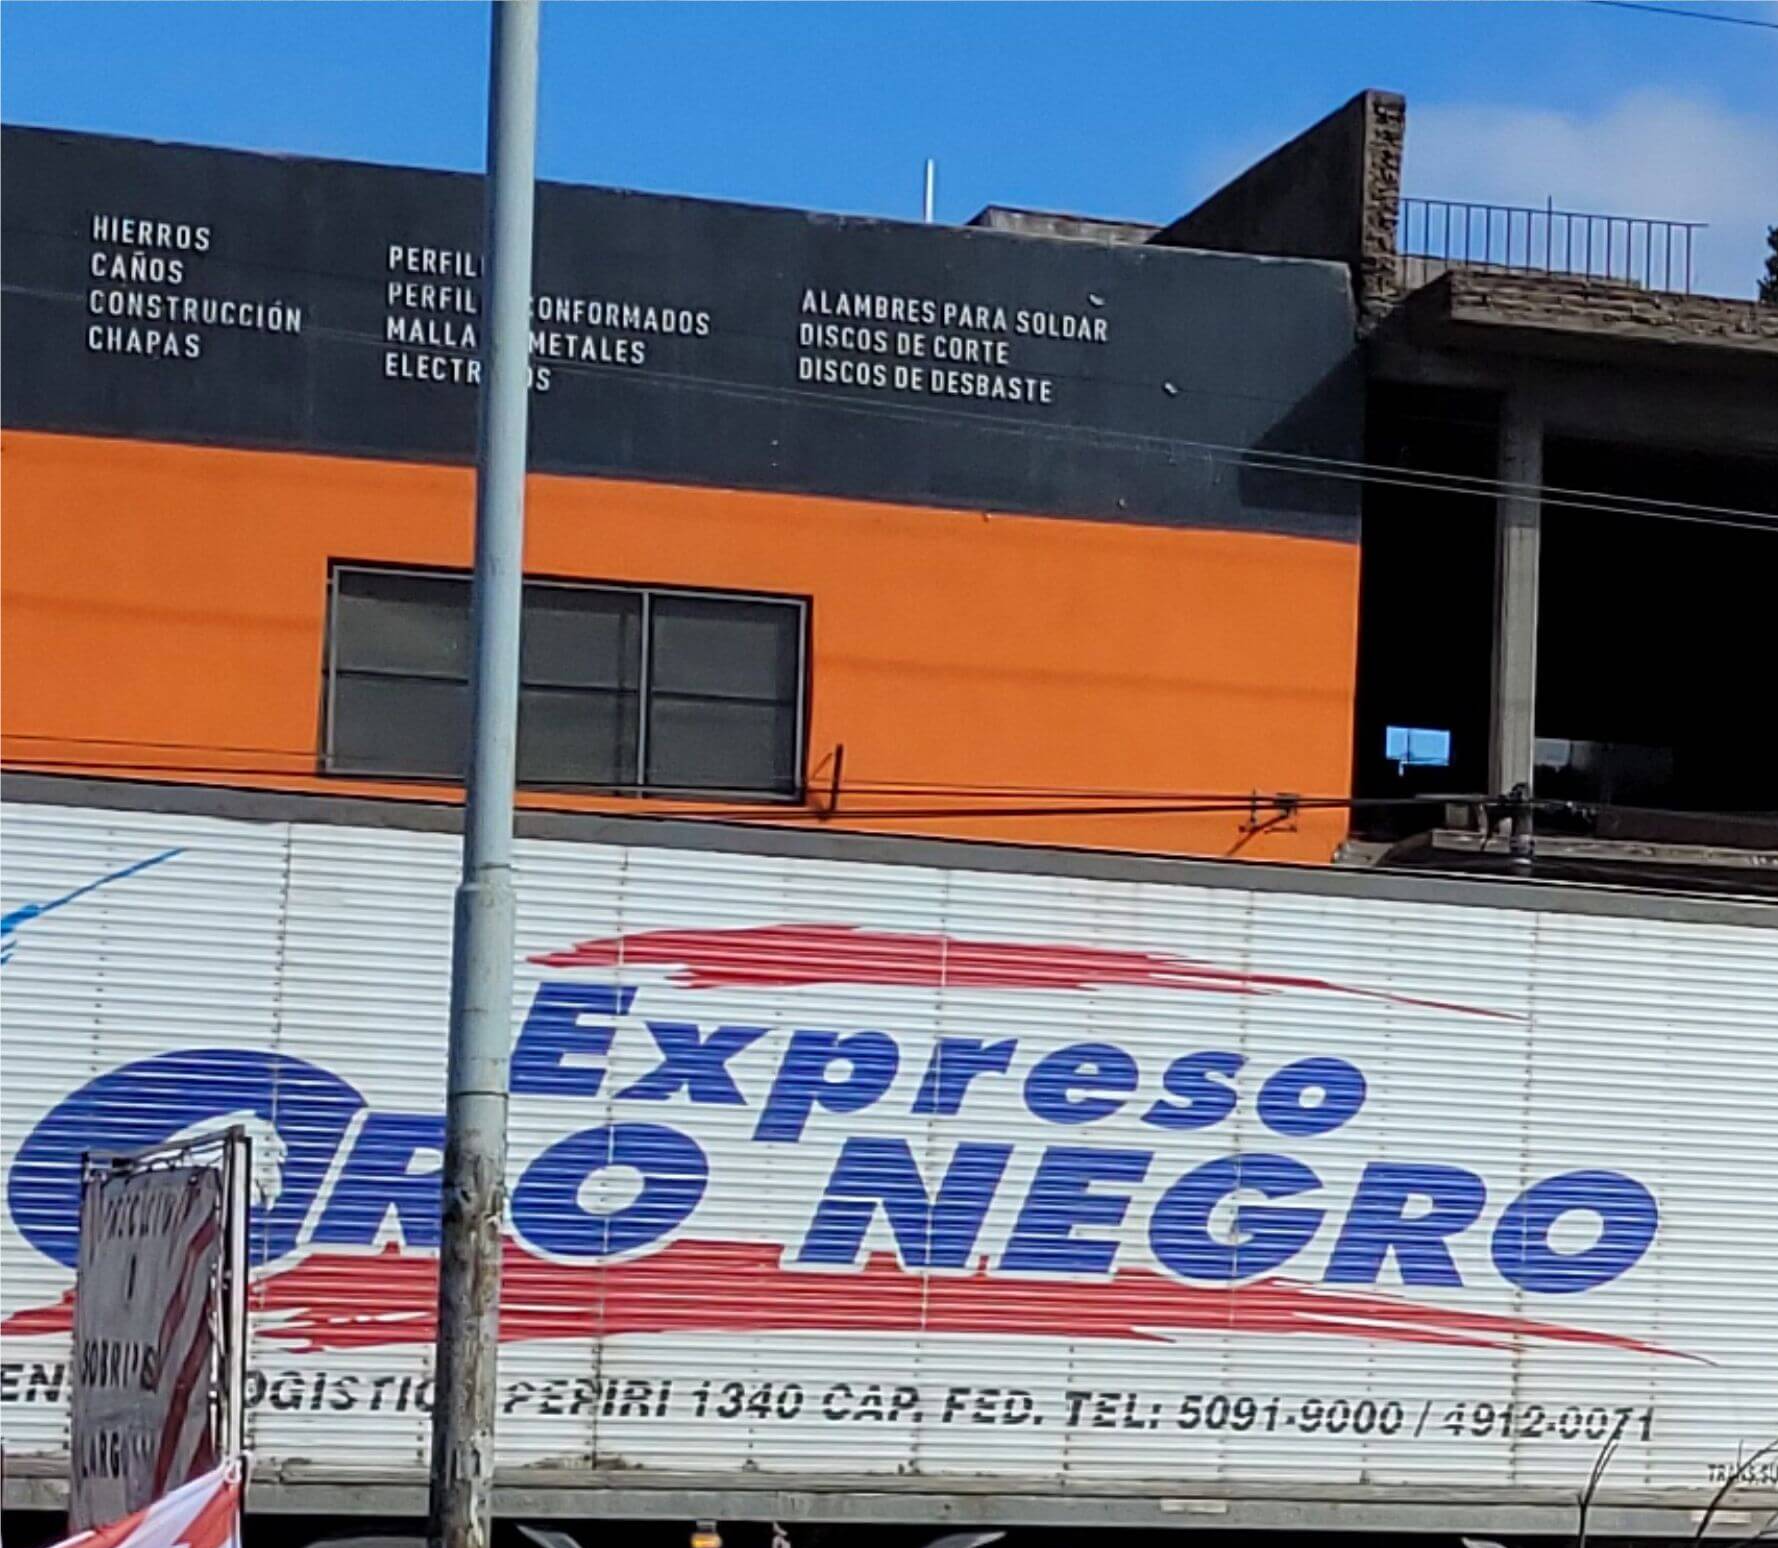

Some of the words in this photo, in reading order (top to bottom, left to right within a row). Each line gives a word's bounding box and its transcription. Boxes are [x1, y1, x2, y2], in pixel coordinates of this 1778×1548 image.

[93, 215, 211, 251] HIERROS
[91, 251, 184, 284] CAÑOS
[389, 246, 485, 277] PERFIL
[89, 290, 301, 333] CONSTRUCCIÓN
[388, 282, 477, 314] PERFIL
[802, 289, 937, 325] ALAMBRES
[943, 303, 1008, 332] PARA
[1015, 311, 1109, 342] SOLDAR
[88, 326, 201, 358] CHAPAS
[387, 316, 477, 348] MALLA
[529, 331, 645, 364] METALES
[800, 323, 888, 355] DISCOS
[898, 333, 925, 357] DE
[933, 336, 1010, 364] CORTE
[799, 357, 886, 388] DISCOS
[894, 366, 923, 391] DE
[931, 370, 1053, 403] DESBASTE
[508, 983, 1367, 1141] Expreso
[799, 1137, 1658, 1293] NEGRO
[244, 1370, 438, 1412] OGISTIC
[502, 1378, 672, 1416] PEPIRI
[692, 1380, 803, 1419] 1340
[1064, 1391, 1162, 1429] TEL:
[1178, 1395, 1402, 1436] 5091-9000
